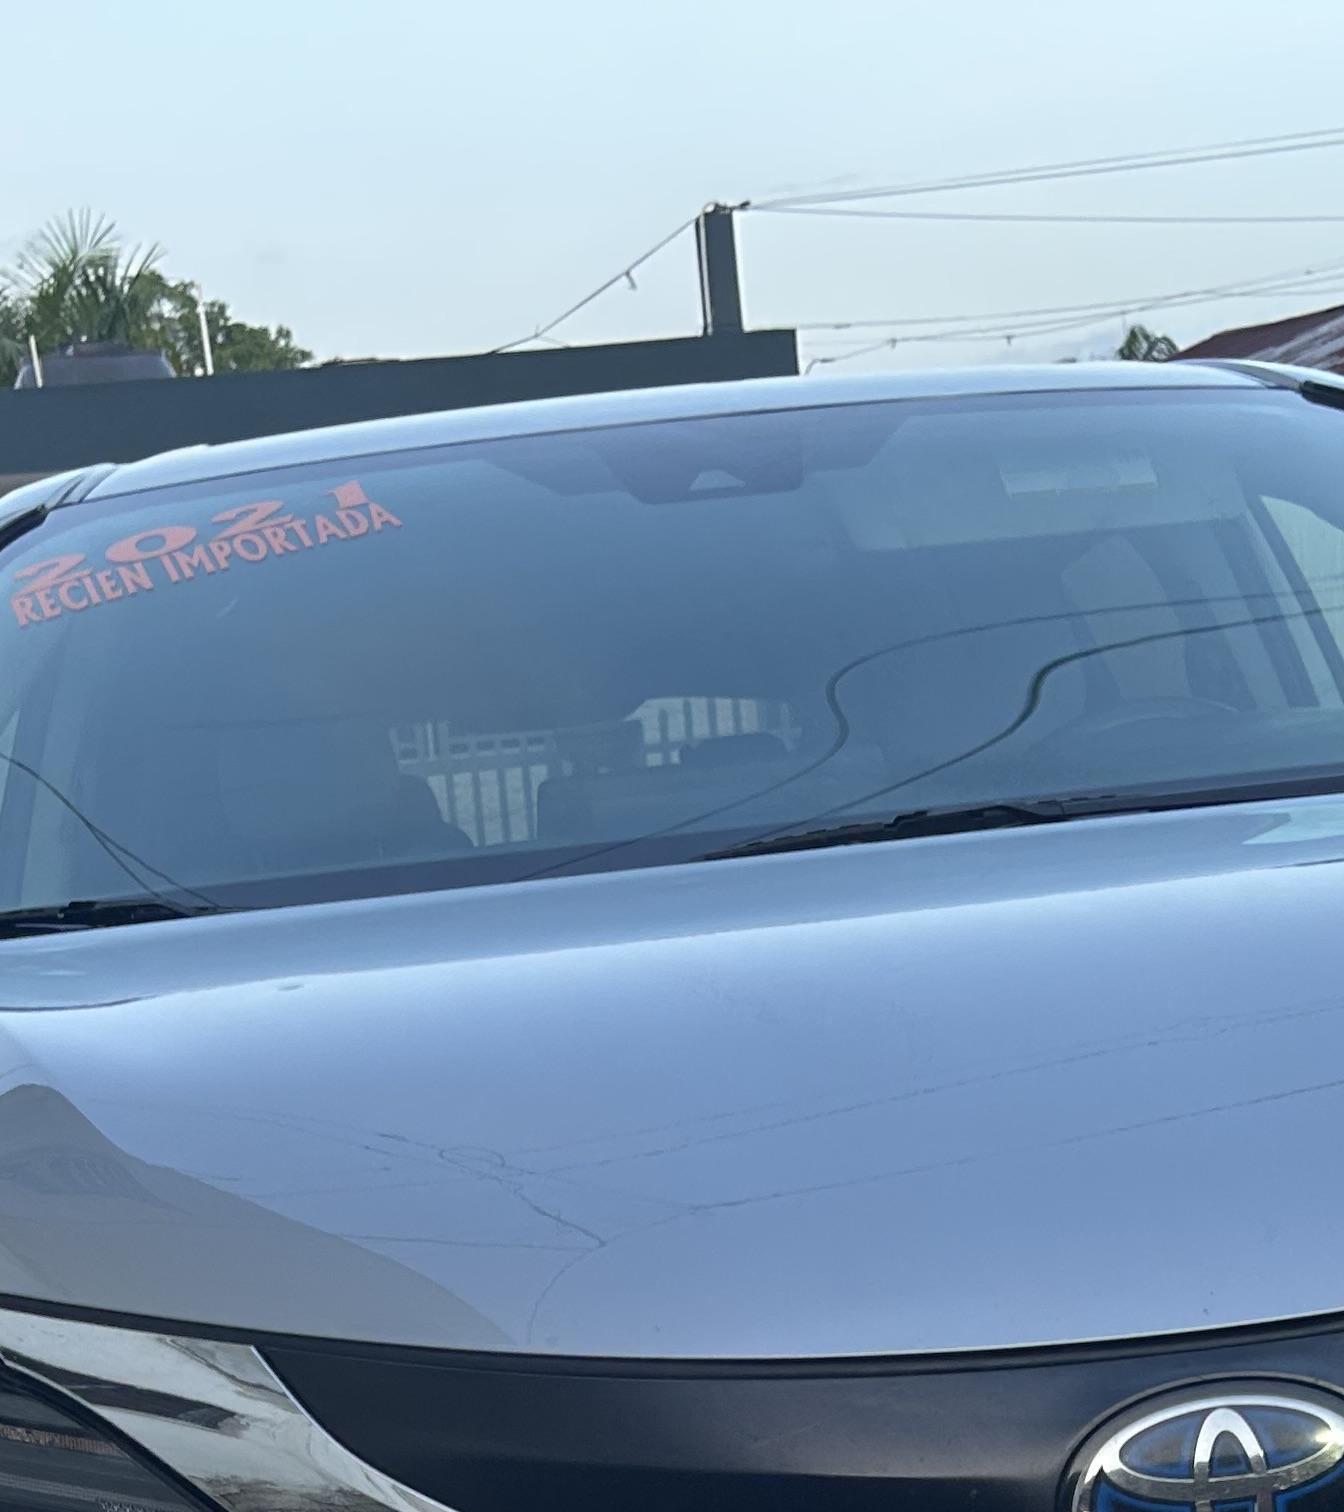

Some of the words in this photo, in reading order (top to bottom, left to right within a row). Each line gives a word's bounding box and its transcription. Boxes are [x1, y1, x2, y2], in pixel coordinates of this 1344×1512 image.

[10, 560, 154, 629] RECIEN
[158, 501, 403, 584] IMPORTADA
[12, 479, 370, 600] 2021
